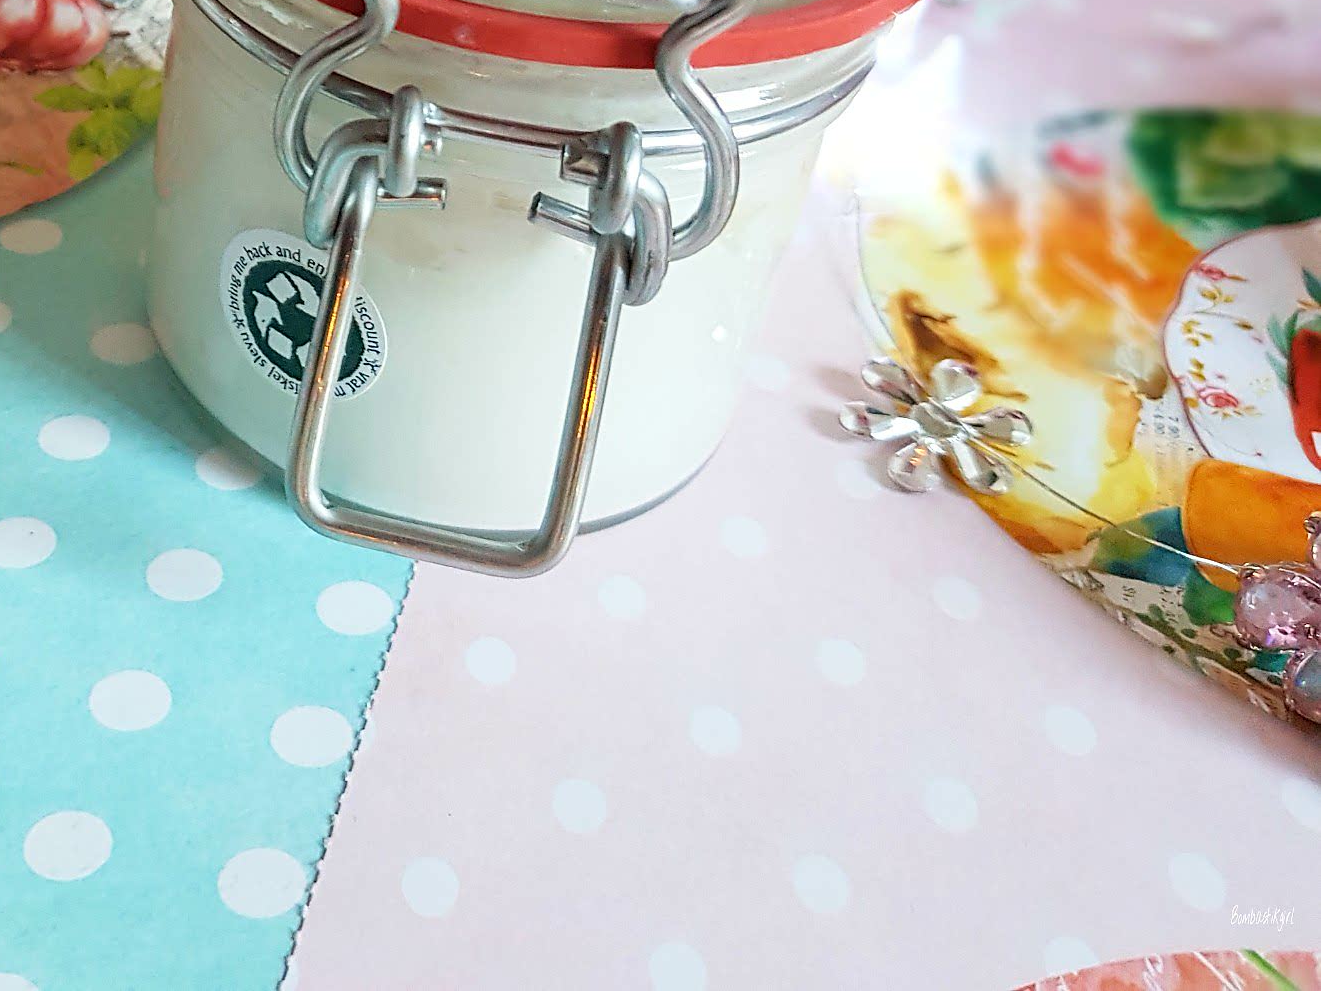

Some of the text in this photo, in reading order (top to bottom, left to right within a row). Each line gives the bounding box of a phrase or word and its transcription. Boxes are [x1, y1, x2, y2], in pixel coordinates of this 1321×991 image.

[242, 241, 273, 262] back
[275, 245, 302, 263] and
[233, 254, 248, 277] me
[228, 272, 243, 312] bring
[240, 331, 269, 368] slevu
